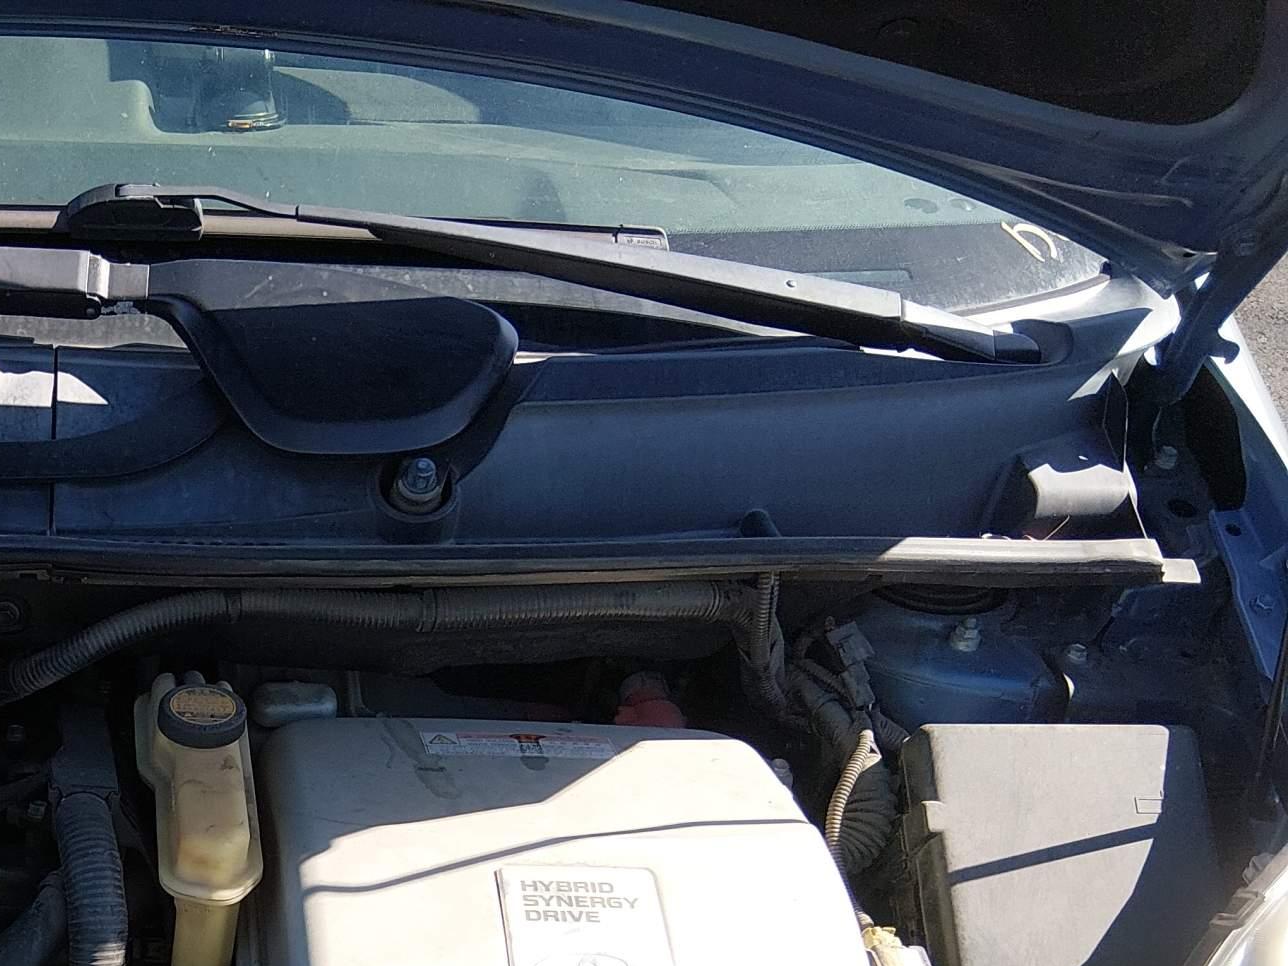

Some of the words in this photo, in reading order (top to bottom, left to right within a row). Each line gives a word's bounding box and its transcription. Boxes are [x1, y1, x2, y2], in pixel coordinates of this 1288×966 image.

[520, 880, 614, 893] HYBRID
[522, 895, 639, 909] SYNERGY
[524, 909, 601, 923] DRIVE
